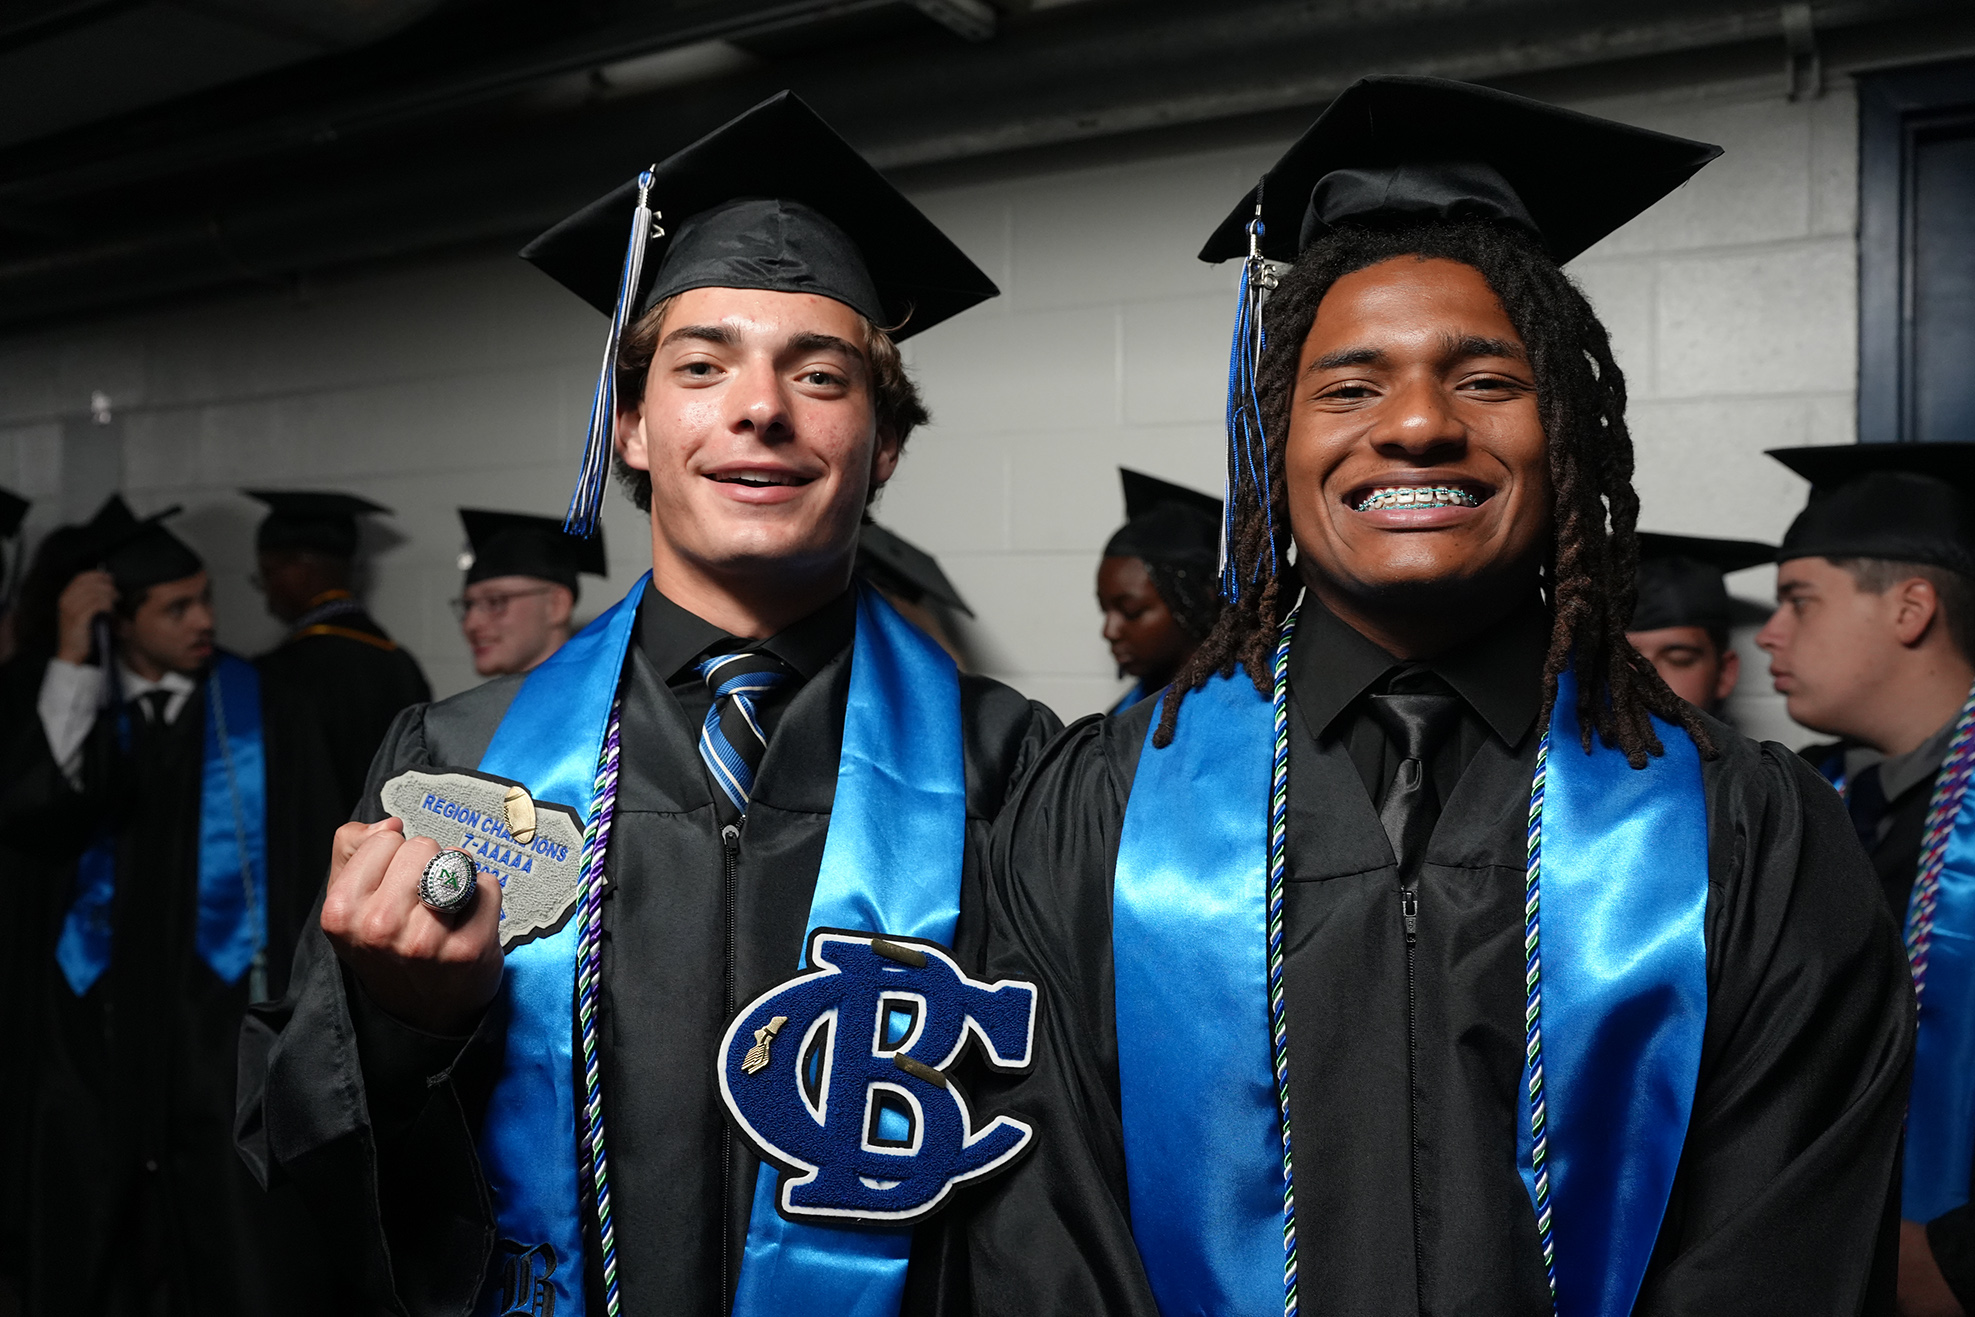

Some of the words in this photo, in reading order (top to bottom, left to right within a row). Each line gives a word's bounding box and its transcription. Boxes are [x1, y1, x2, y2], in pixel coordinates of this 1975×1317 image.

[421, 794, 479, 829] REGION
[480, 817, 569, 863] CHAIONS
[460, 833, 534, 874] 7-AAAAA
